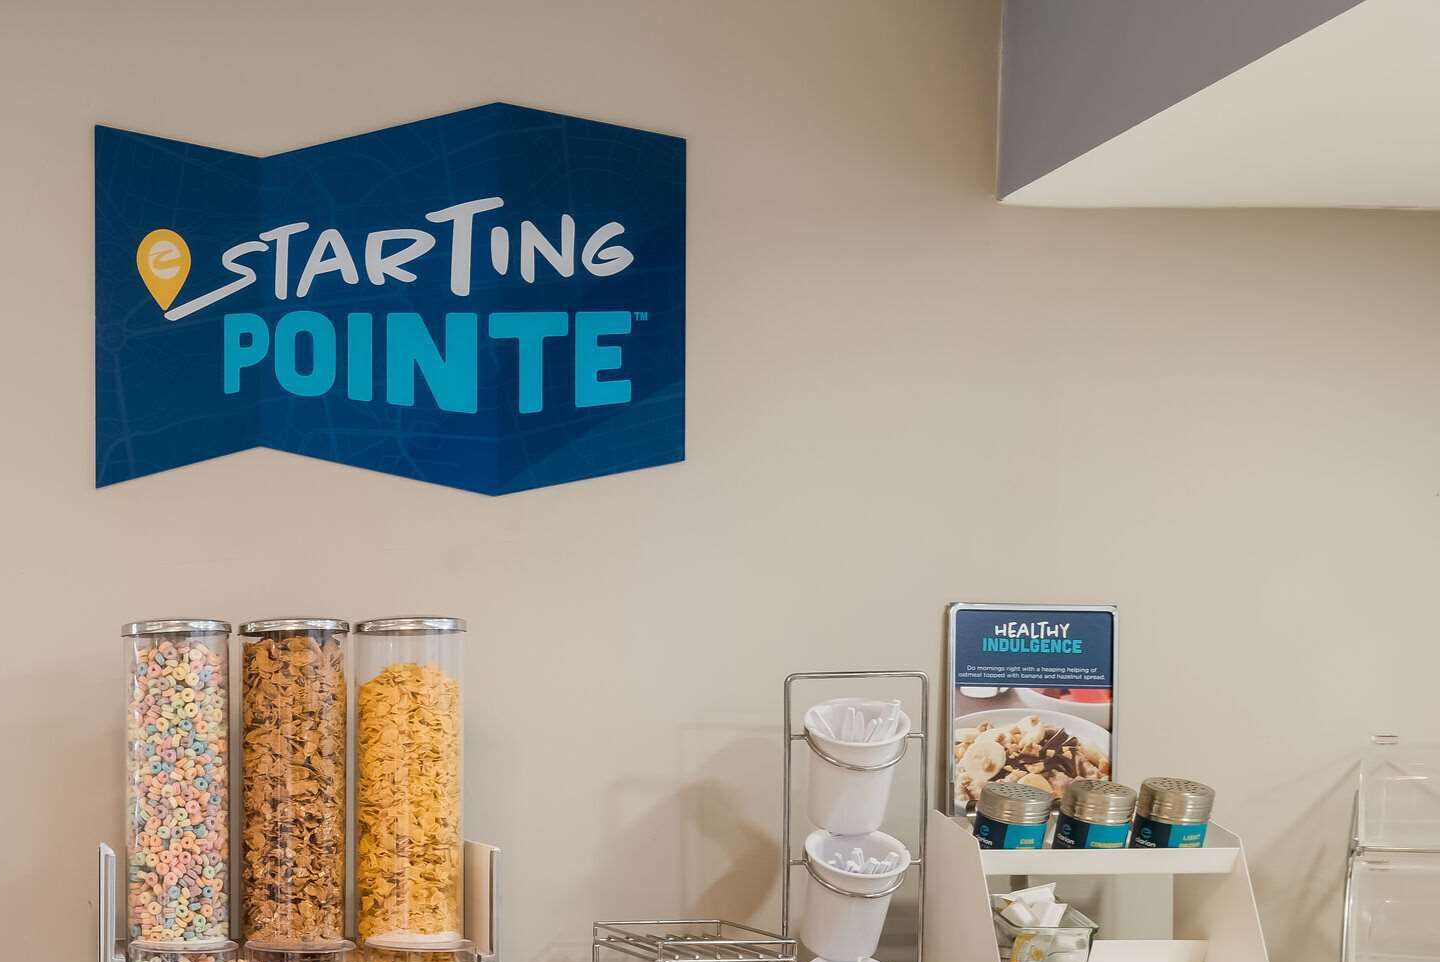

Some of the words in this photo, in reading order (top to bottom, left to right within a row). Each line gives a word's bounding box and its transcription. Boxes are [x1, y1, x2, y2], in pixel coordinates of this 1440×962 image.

[163, 196, 635, 322] STARTING
[223, 310, 633, 414] POINTE
[994, 621, 1070, 639] HEALTHY
[982, 638, 1082, 654] INDULGENCE
[966, 664, 976, 672] Do
